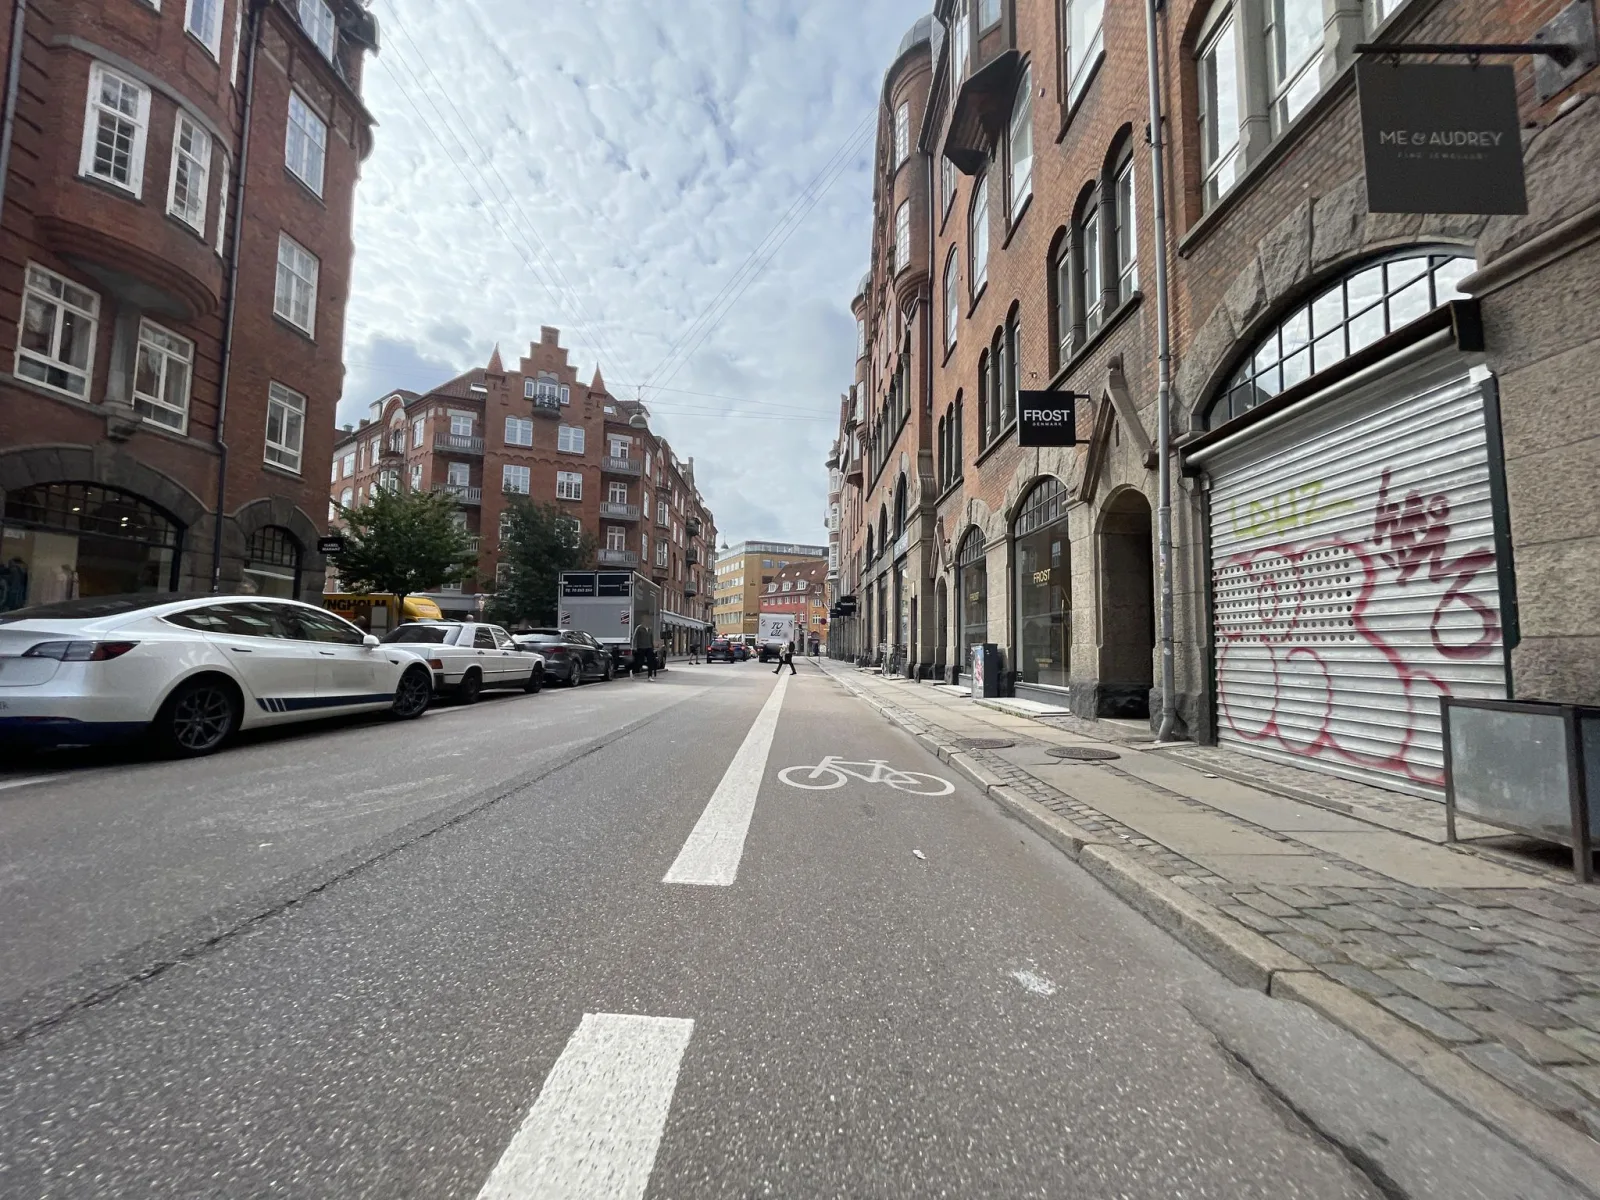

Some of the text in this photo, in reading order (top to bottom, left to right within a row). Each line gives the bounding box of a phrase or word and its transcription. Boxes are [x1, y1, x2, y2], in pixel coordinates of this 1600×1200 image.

[1379, 130, 1504, 147] ME & AUDREY
[1023, 409, 1071, 422] FROST
[1033, 568, 1051, 585] FROST
